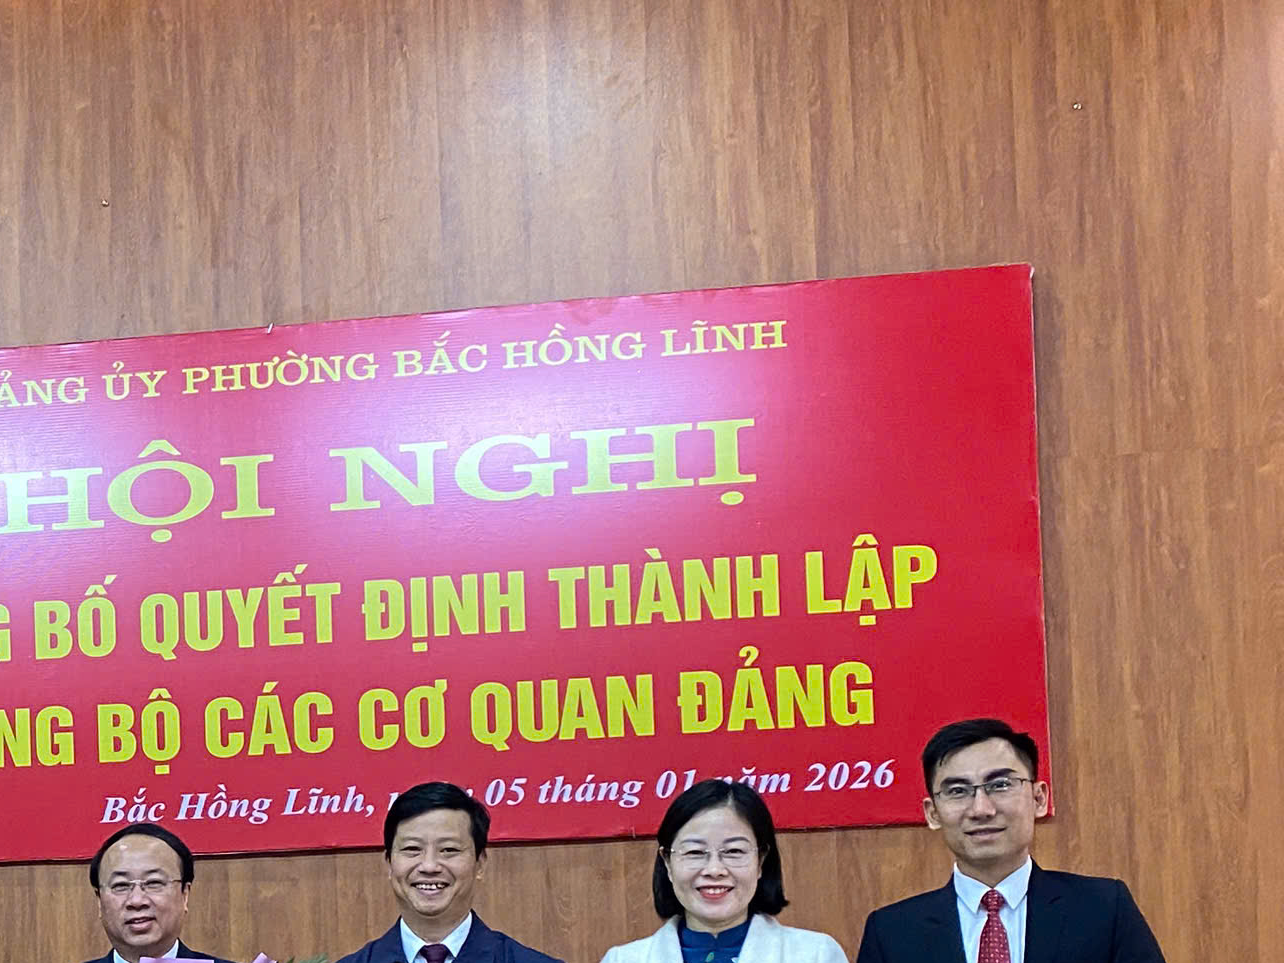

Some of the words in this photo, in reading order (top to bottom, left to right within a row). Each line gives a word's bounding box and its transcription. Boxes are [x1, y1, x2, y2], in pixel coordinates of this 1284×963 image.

[102, 360, 167, 401] ỦY
[182, 349, 380, 395] PHƯỜNG
[393, 330, 488, 378] BẮC
[501, 322, 647, 369] HỒNG
[660, 319, 788, 358] LĨNH
[328, 417, 758, 511] NGHỊ
[33, 574, 118, 660] BỐ
[139, 563, 342, 661] QUYẾT
[361, 570, 526, 653] ĐỊNH
[547, 547, 781, 630] THÀNH
[804, 533, 938, 626] LẬP
[97, 687, 181, 775] BỘ
[204, 681, 334, 759] CÁC
[358, 678, 448, 751] CƠ
[470, 673, 655, 752] QUAN
[676, 645, 875, 734] ĐẢNG
[100, 787, 165, 824] Bắc
[175, 783, 272, 825] Hồng
[282, 785, 375, 818] Lĩnh,
[485, 777, 528, 807] 05
[538, 774, 645, 808] tháng
[656, 769, 697, 799] 01
[713, 766, 792, 794] ăm
[804, 759, 895, 792] 2026
